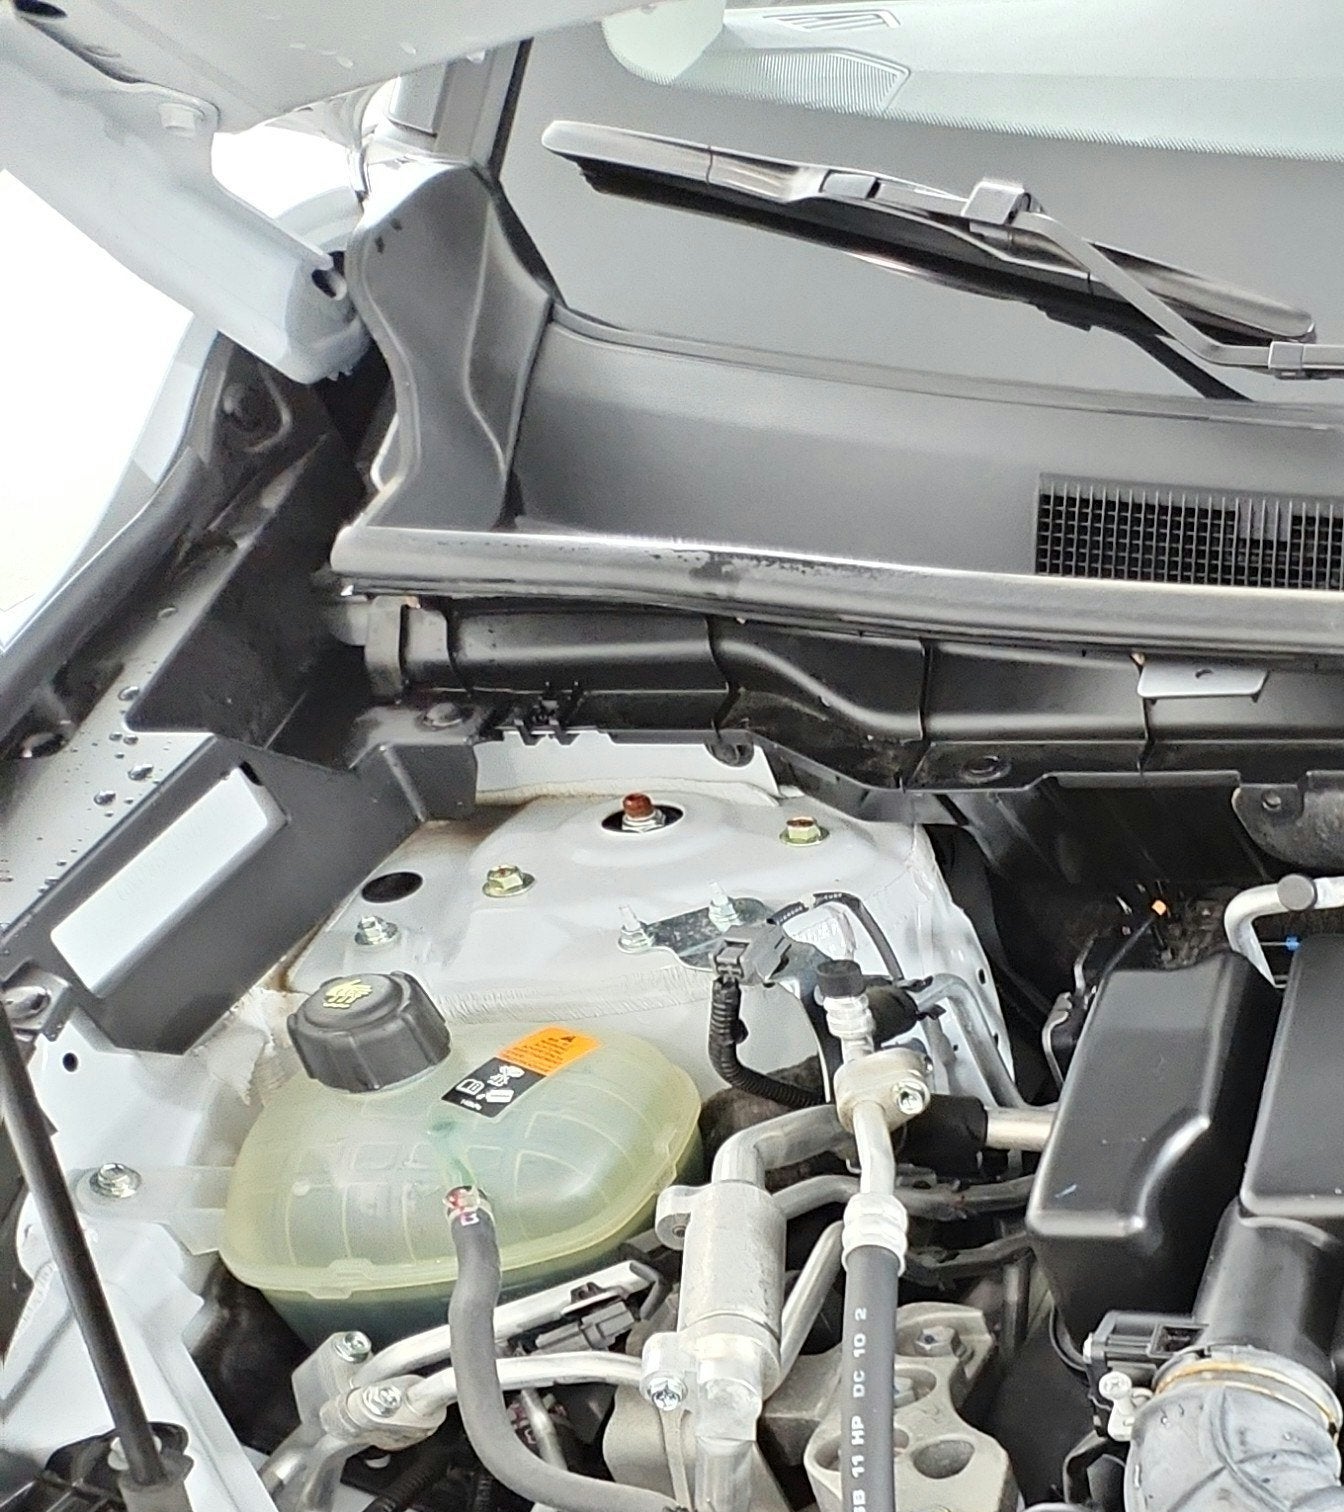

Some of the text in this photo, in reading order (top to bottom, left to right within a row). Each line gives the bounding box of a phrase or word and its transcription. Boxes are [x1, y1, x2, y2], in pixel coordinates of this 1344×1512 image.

[854, 1307, 867, 1321] 2
[853, 1332, 867, 1358] 10
[852, 1369, 866, 1398] DC
[851, 1415, 865, 1446] HP
[851, 1454, 865, 1478] 11
